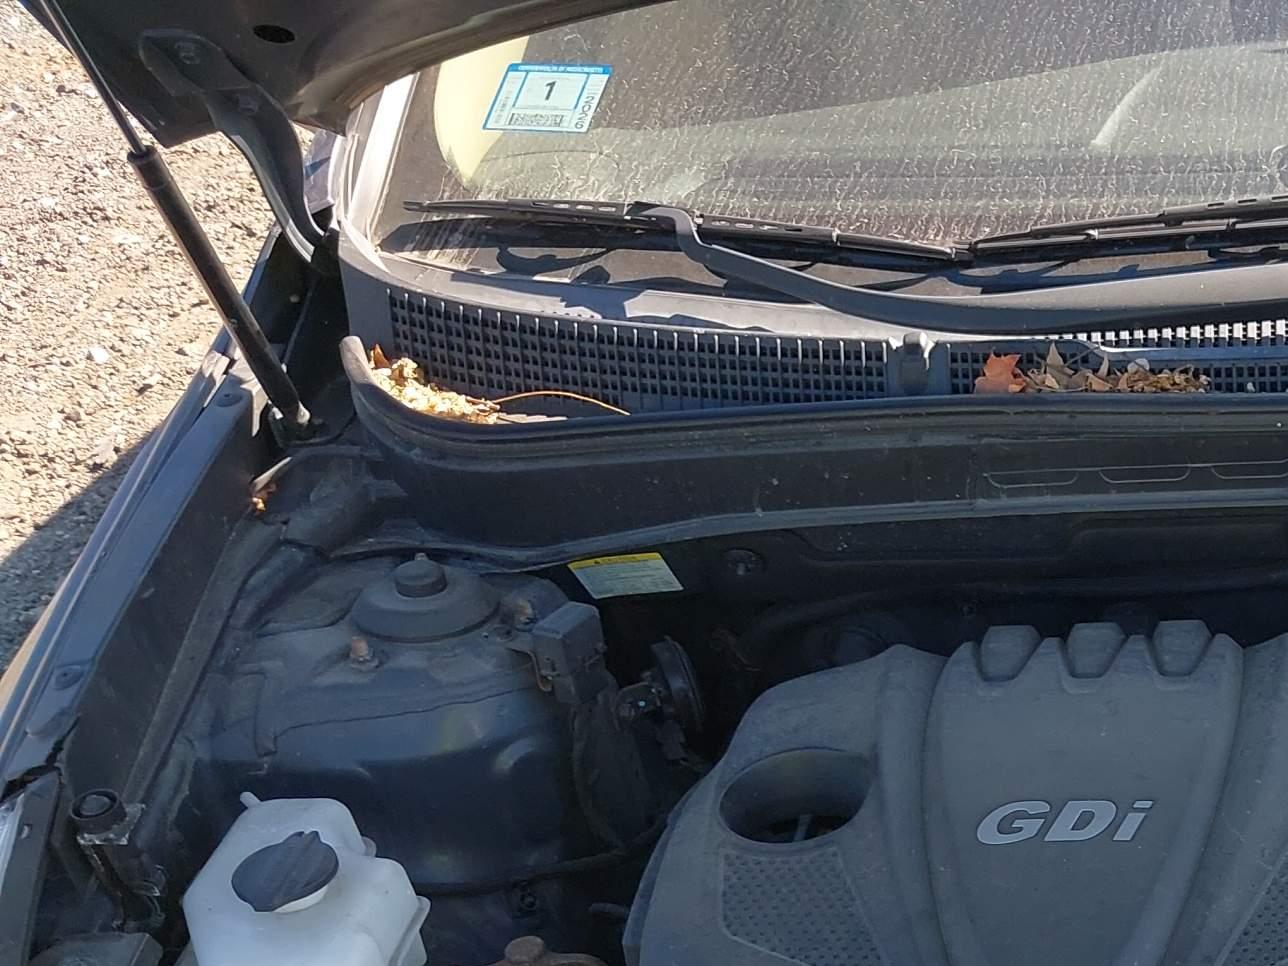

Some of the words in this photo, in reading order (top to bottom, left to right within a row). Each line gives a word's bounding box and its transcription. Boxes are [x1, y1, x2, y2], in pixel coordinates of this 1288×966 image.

[545, 80, 557, 101] 1
[574, 95, 595, 130] 2026
[976, 799, 1154, 845] GDi
